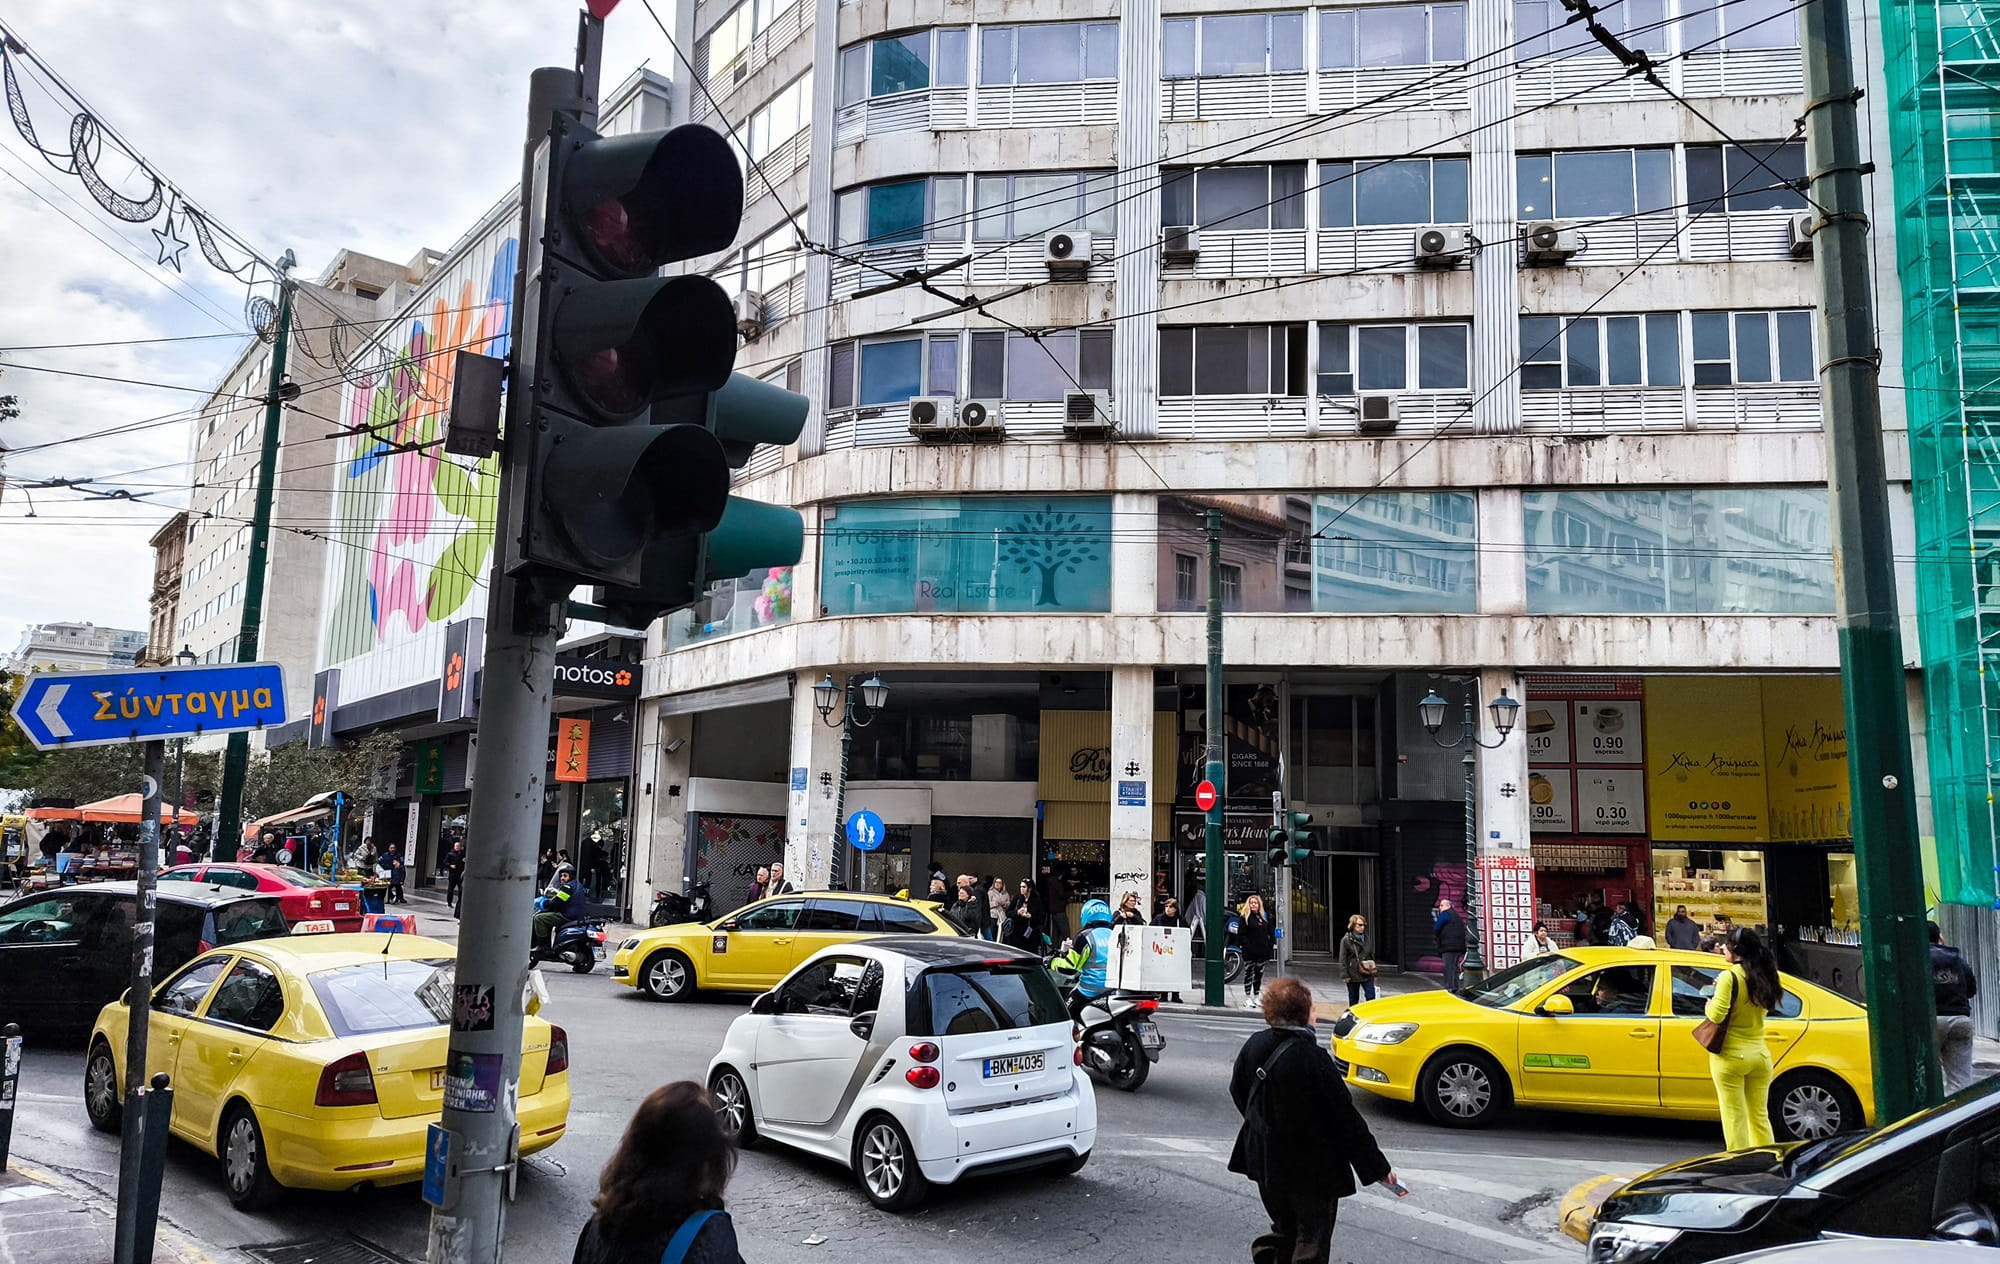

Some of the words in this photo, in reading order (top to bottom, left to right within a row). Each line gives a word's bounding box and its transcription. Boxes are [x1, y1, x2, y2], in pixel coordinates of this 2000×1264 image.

[834, 522, 946, 549] Prosperity
[920, 580, 956, 598] Real
[966, 580, 1016, 598] Estate
[553, 664, 614, 686] notos
[91, 687, 272, 720] Σύνταγμα
[1593, 736, 1623, 748] 0.90
[1596, 806, 1627, 819] 0.30
[1240, 826, 1268, 839] Hous
